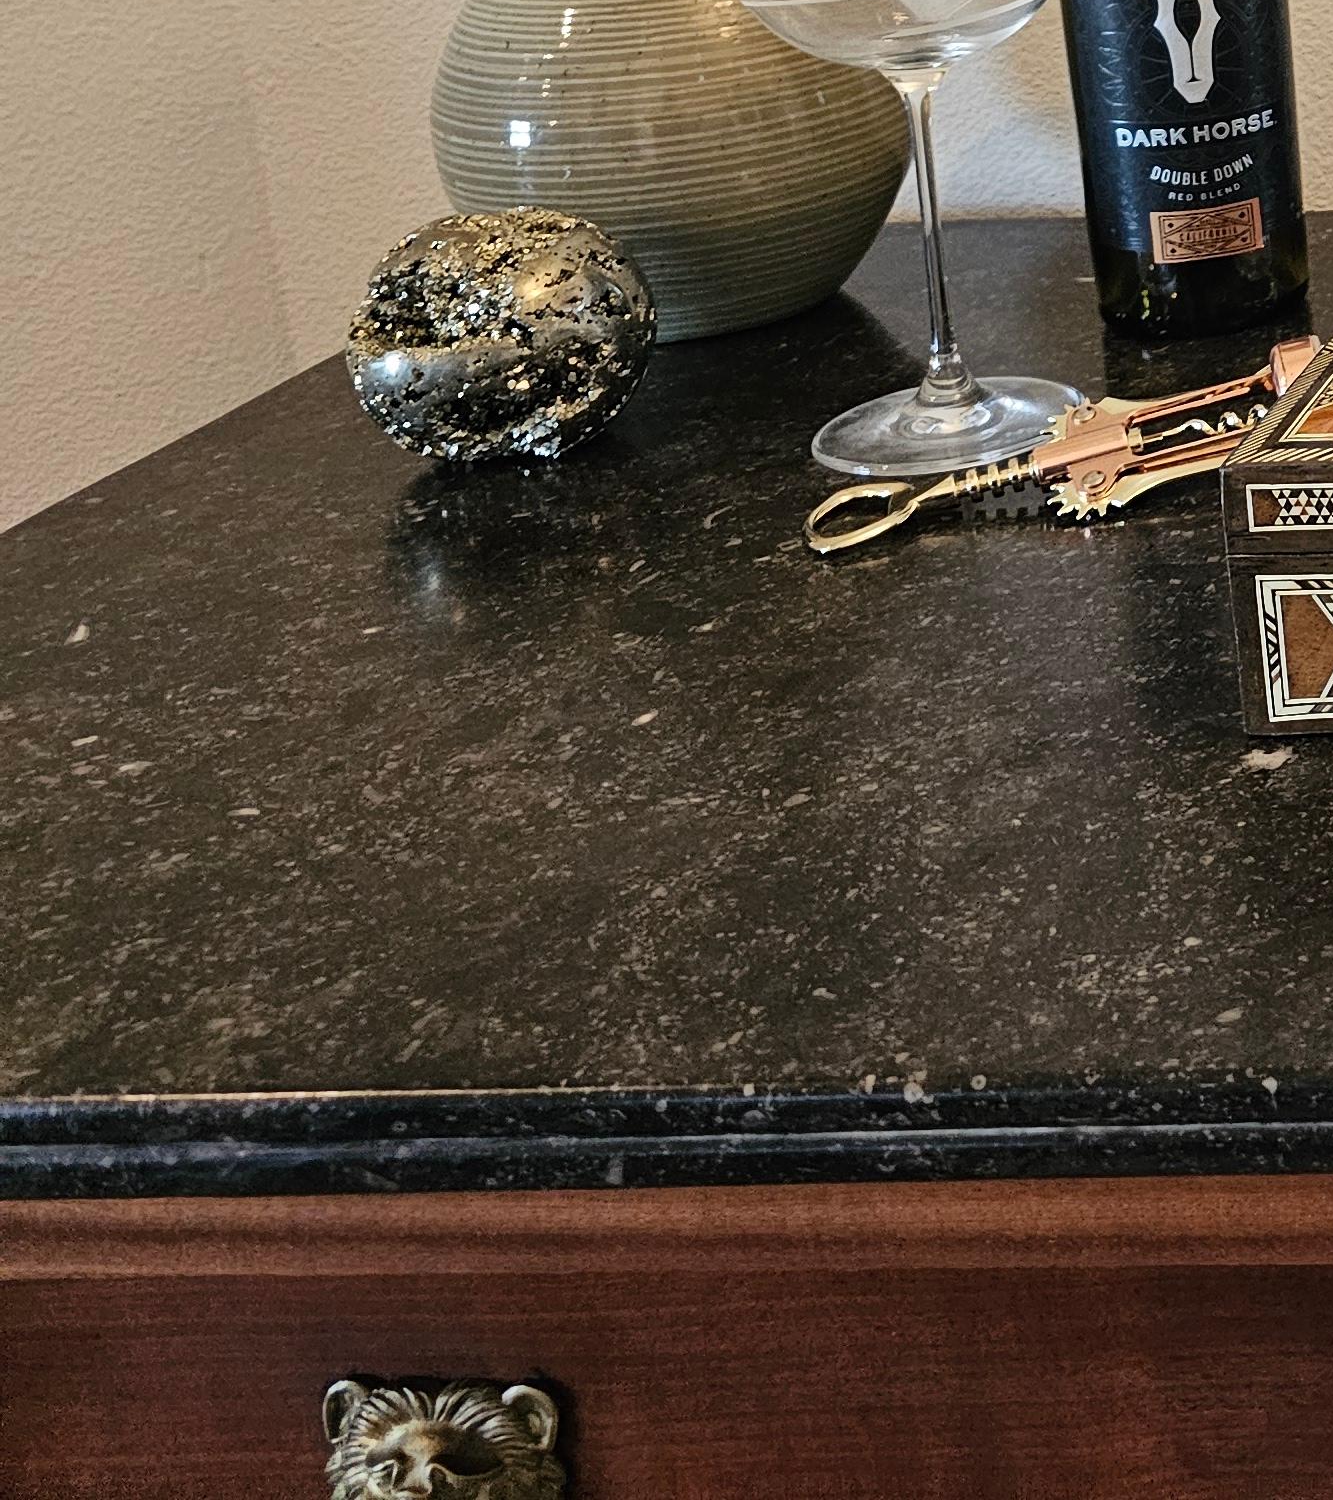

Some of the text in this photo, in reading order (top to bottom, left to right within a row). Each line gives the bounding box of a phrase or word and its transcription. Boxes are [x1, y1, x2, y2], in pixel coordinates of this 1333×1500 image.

[1115, 109, 1274, 147] DARK HORSE
[1150, 153, 1253, 186] DOUBLE DOWN
[1168, 182, 1241, 202] RED BLEND
